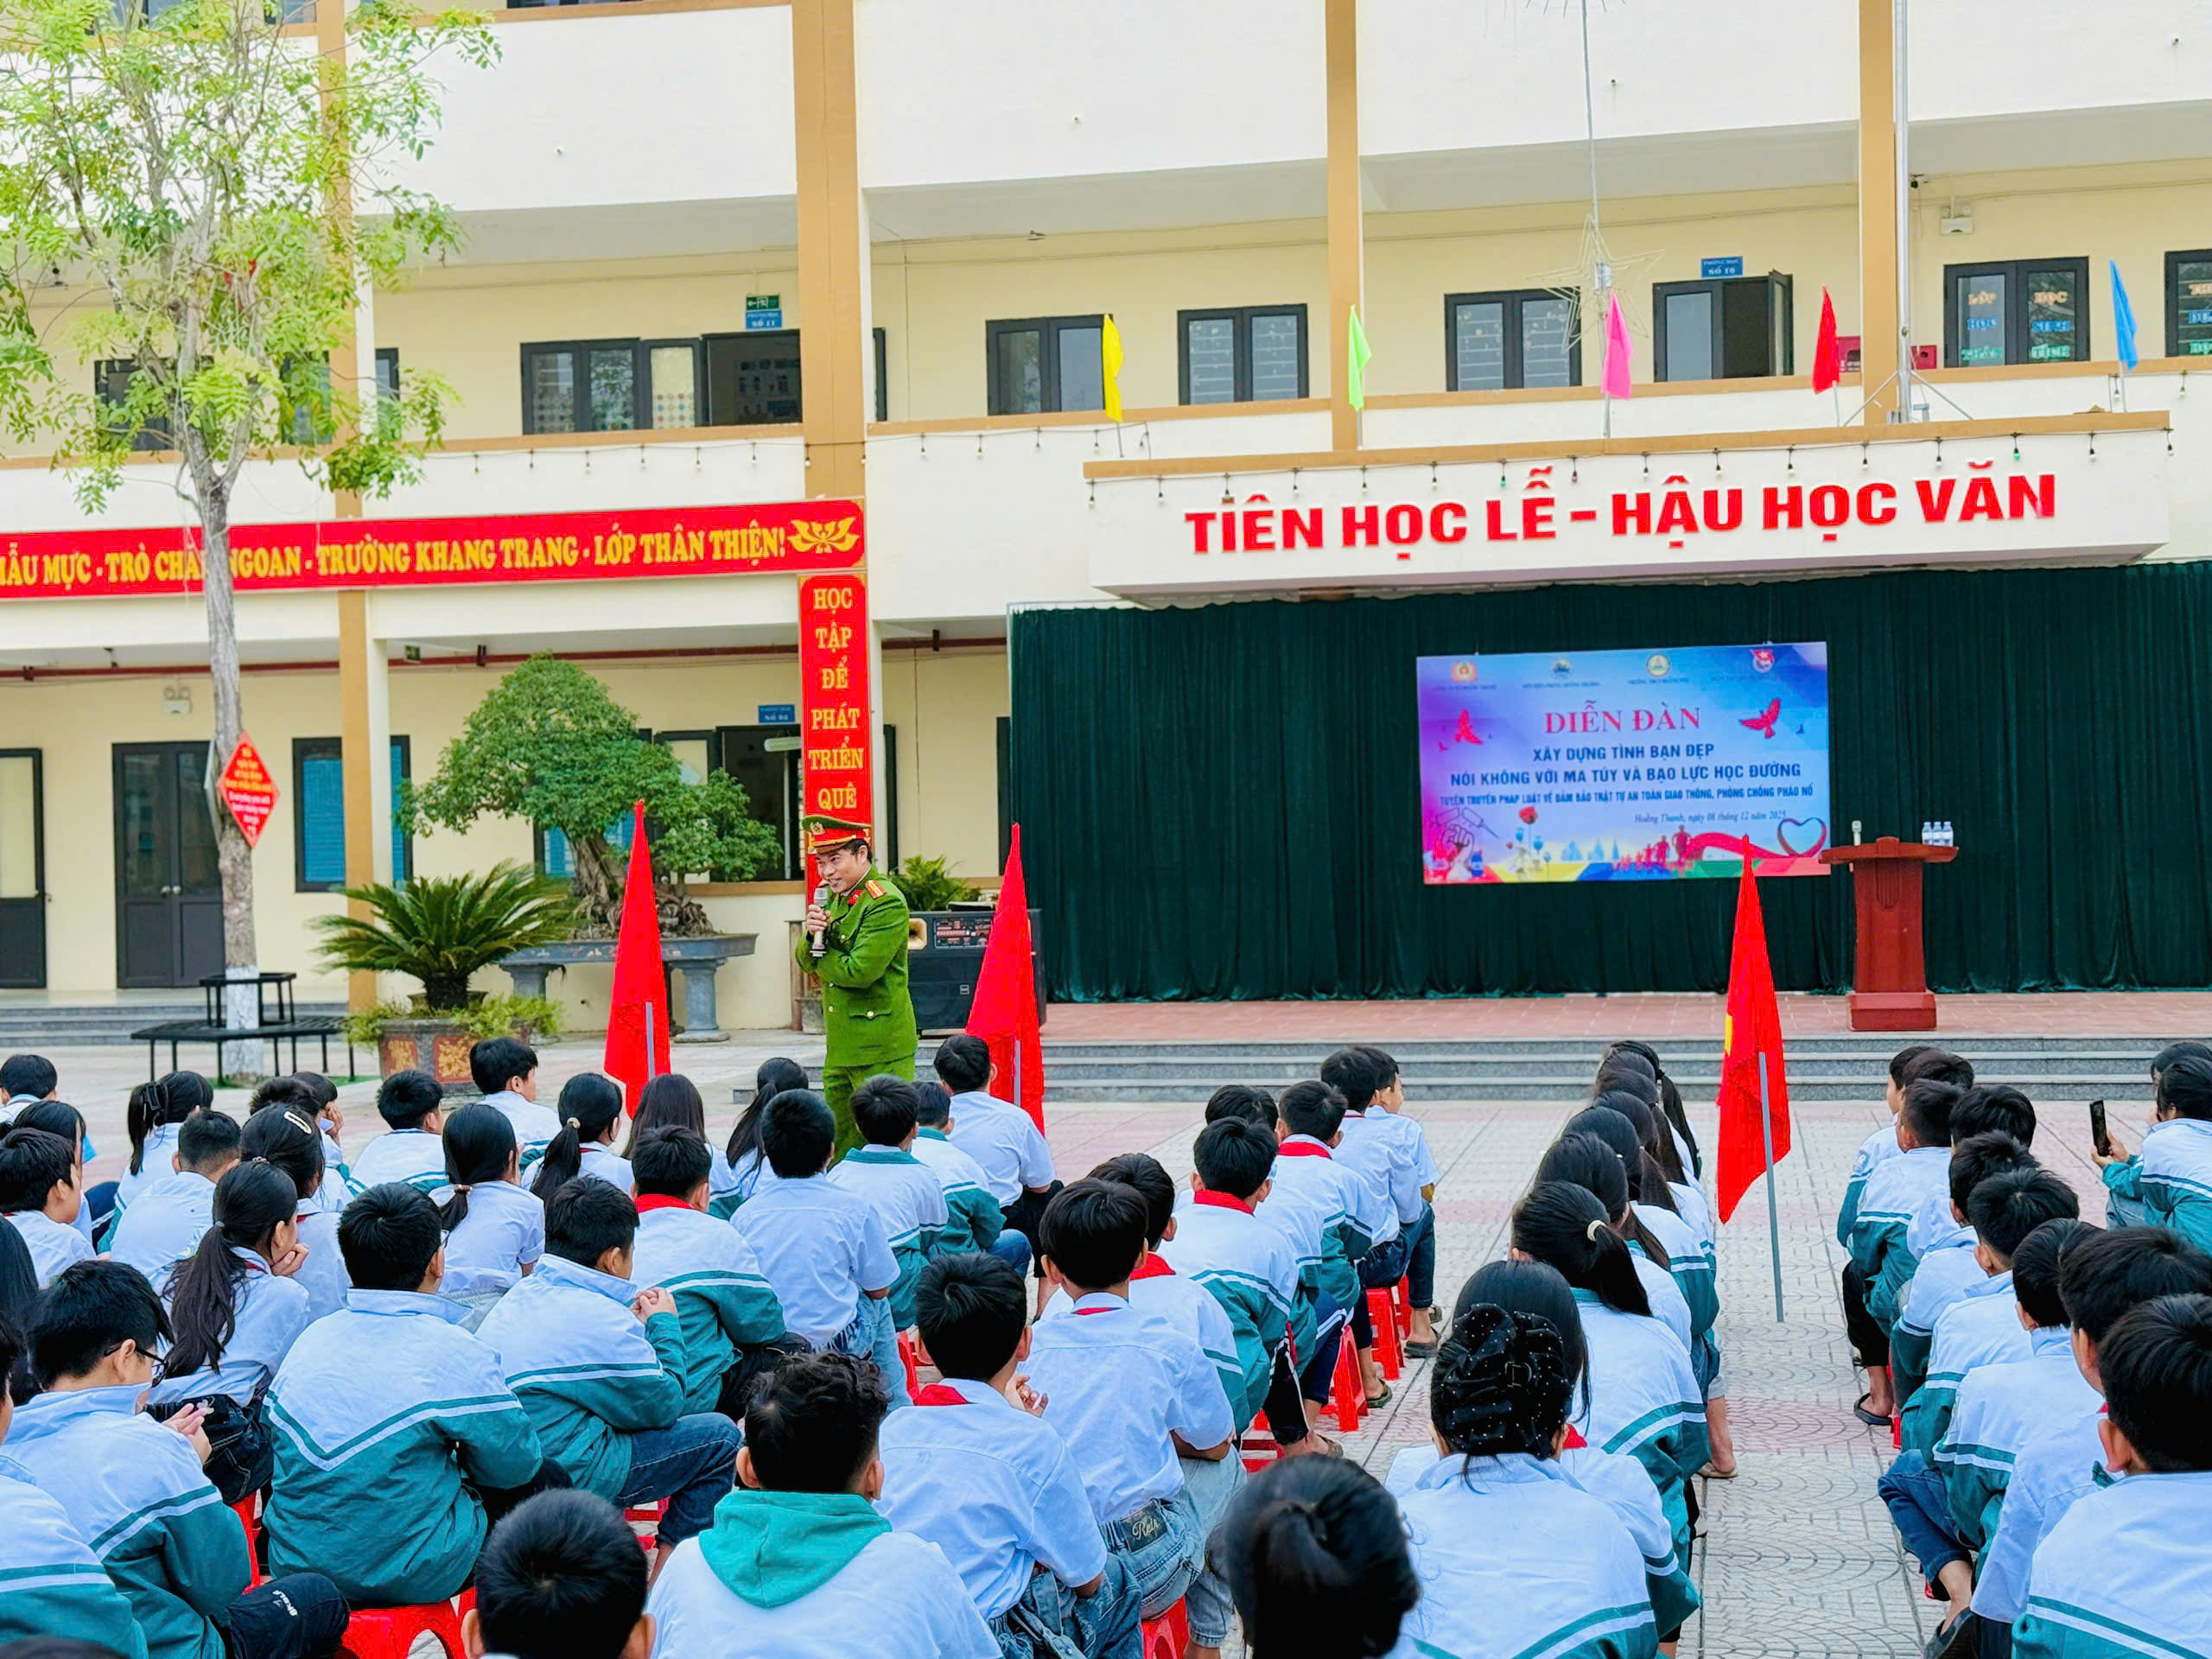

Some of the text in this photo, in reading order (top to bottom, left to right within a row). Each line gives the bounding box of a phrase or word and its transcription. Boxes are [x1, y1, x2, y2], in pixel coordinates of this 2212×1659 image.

[1185, 493, 1324, 554] TIÊN
[1341, 501, 1467, 561] HỌC
[1486, 465, 1556, 541] LỄ
[1612, 475, 1743, 549] HẬU
[1763, 482, 1897, 542] HỌC
[1915, 460, 2055, 523] VĂN
[42, 550, 92, 590] MỰC
[105, 543, 150, 583] TRÒ
[316, 533, 410, 576] TRƯỜNG
[416, 537, 497, 572] KHANG
[499, 536, 578, 569] TRANG
[594, 521, 636, 566] LỚP
[639, 523, 704, 563] THÂN
[709, 519, 786, 567] THIỆN!
[813, 588, 853, 614] HỌC
[815, 622, 851, 652] TẬP
[822, 656, 849, 690] ĐỂ
[810, 701, 860, 729] PHÁT
[1545, 700, 1700, 734] DIỄN ĐÀN
[808, 735, 864, 771] TRIỂN
[1533, 743, 1714, 764] XÂY DỰNG TÌNH BẠN ĐẸP
[1451, 761, 1802, 786] NÓI KHÔNG VỚI MA TÚY VÀ BẠO LỰC HỌC ĐƯỜNG
[817, 781, 857, 810] QUÊ
